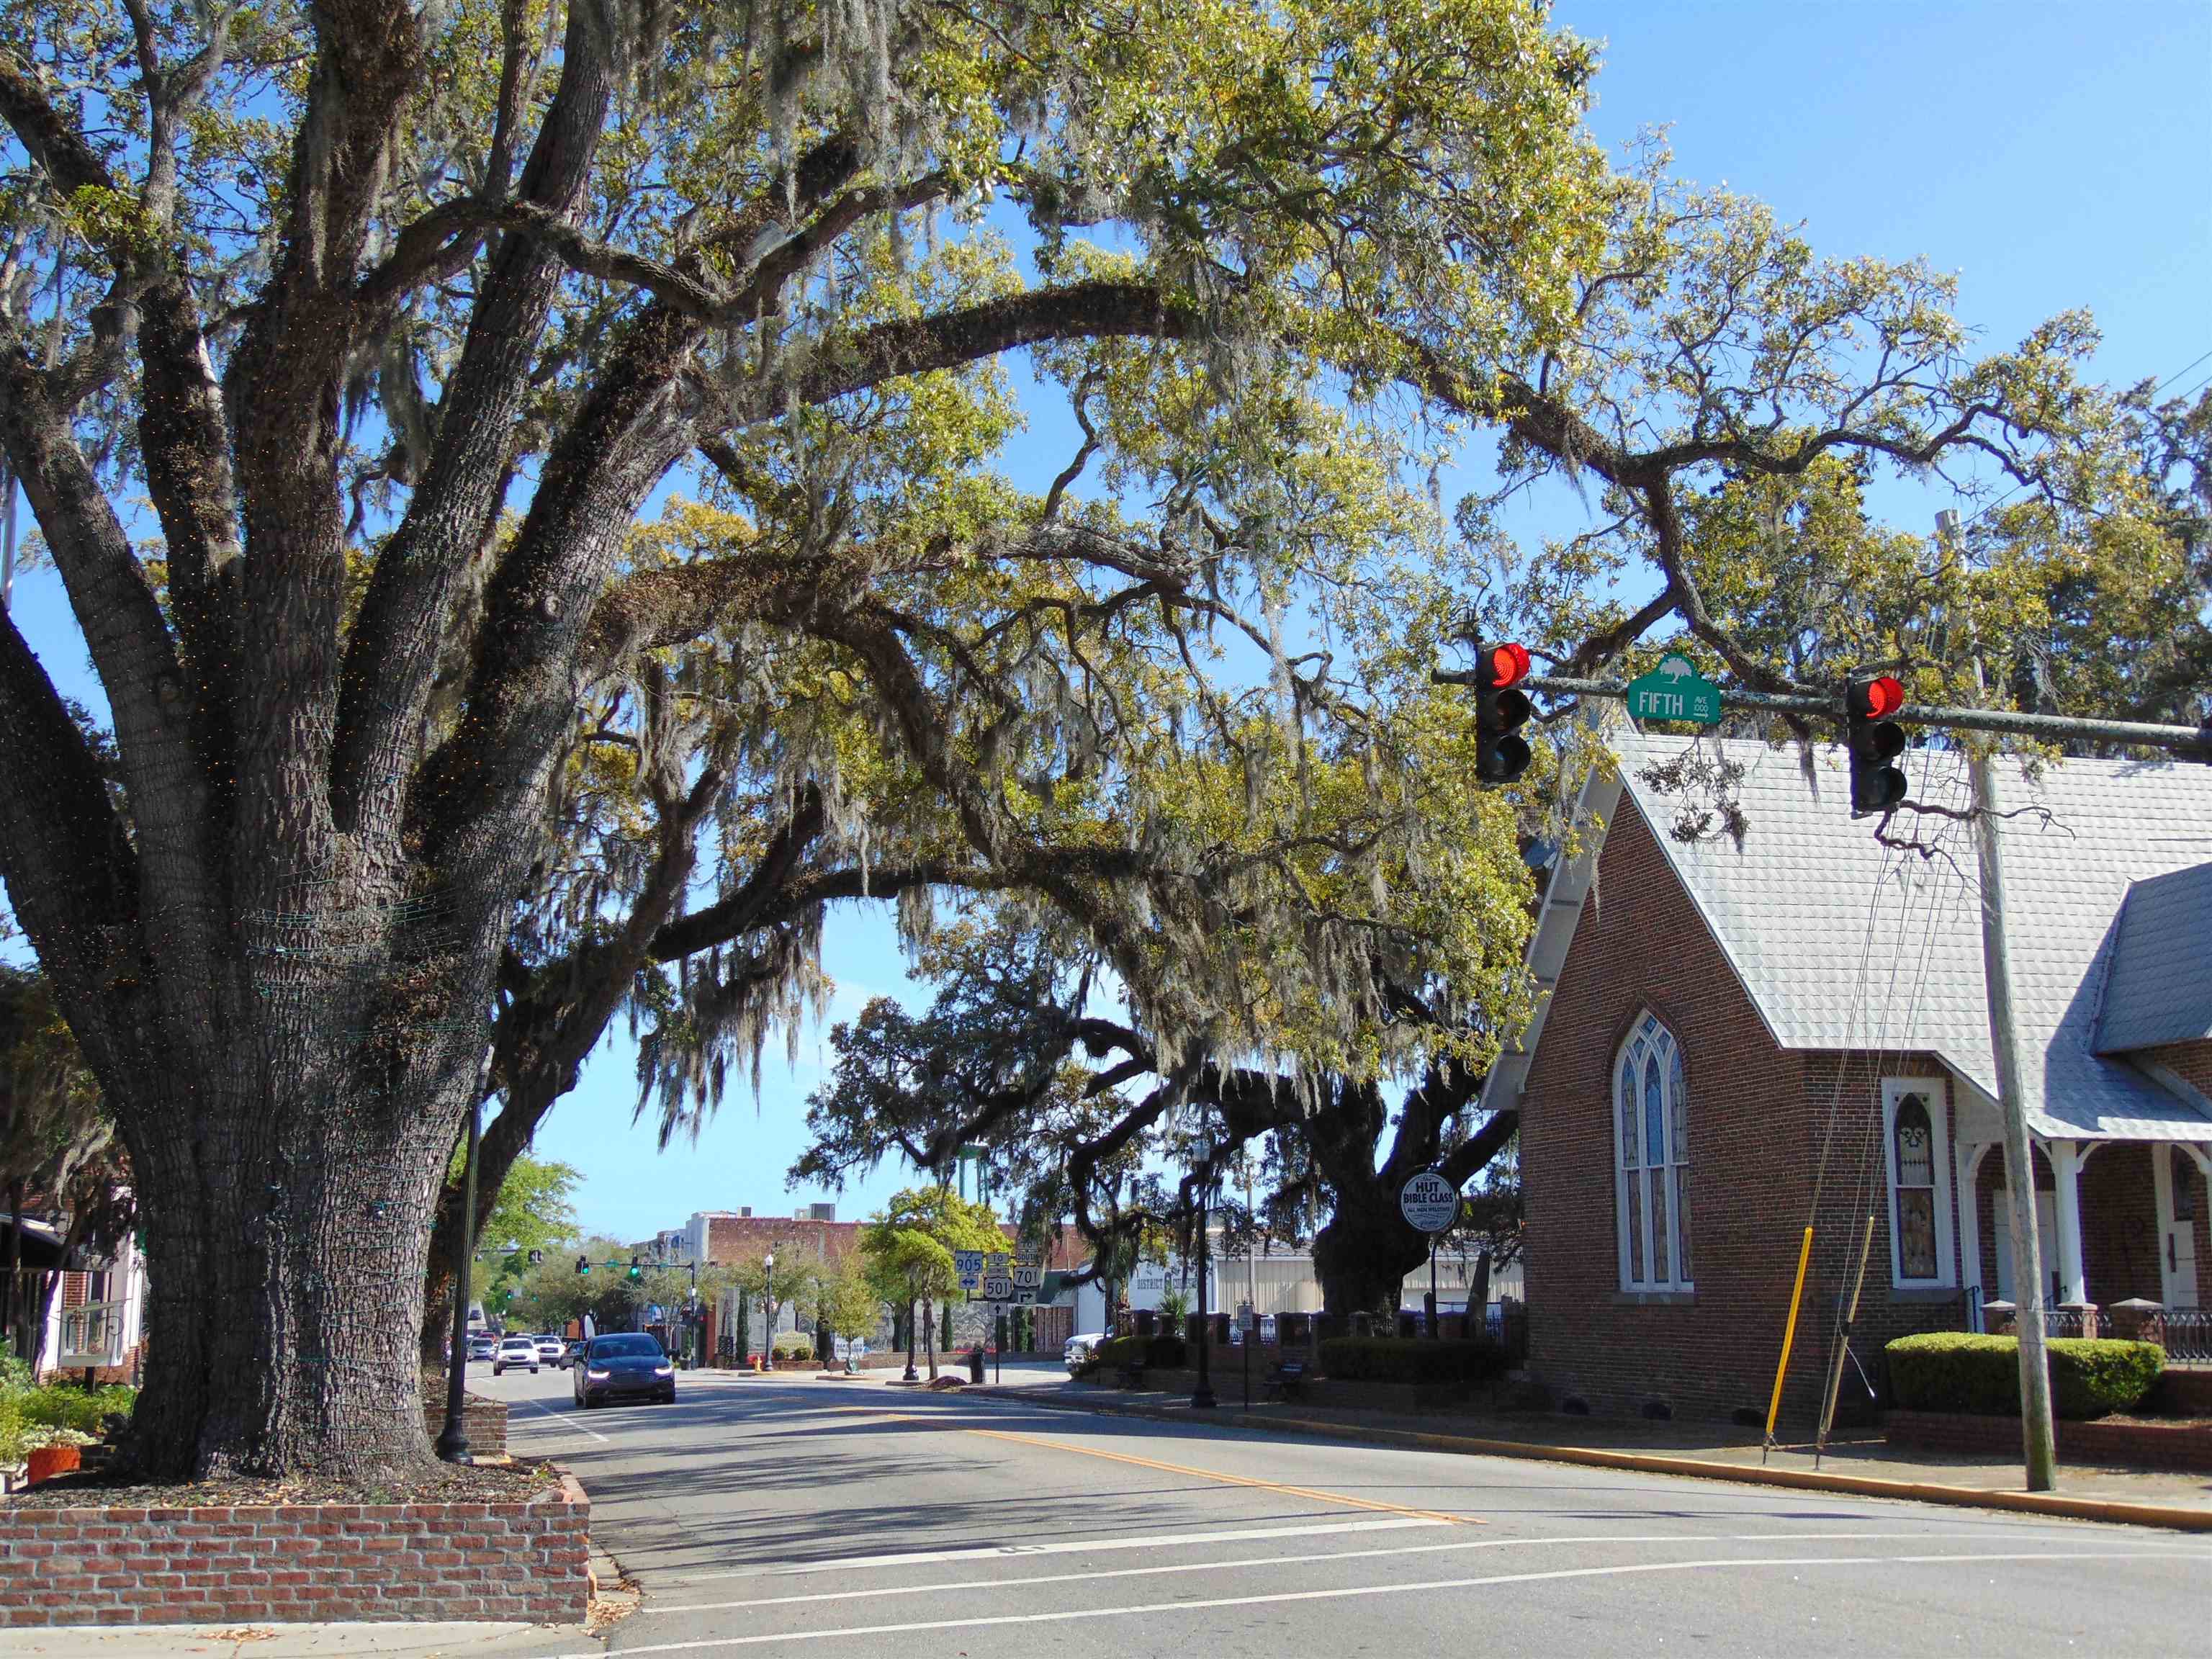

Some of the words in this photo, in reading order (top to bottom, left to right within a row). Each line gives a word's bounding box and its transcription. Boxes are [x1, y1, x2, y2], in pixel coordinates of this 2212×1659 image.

[1639, 691, 1683, 715] FIFTH
[1694, 696, 1707, 704] AVE
[1416, 1182, 1439, 1192] HUT
[1403, 1193, 1427, 1203] BIBLE
[1429, 1192, 1453, 1203] CLASS
[956, 1259, 981, 1272] 905
[1016, 1270, 1037, 1283] 701
[986, 1282, 1007, 1295] 501
[1138, 1278, 1163, 1290] DISTRICT
